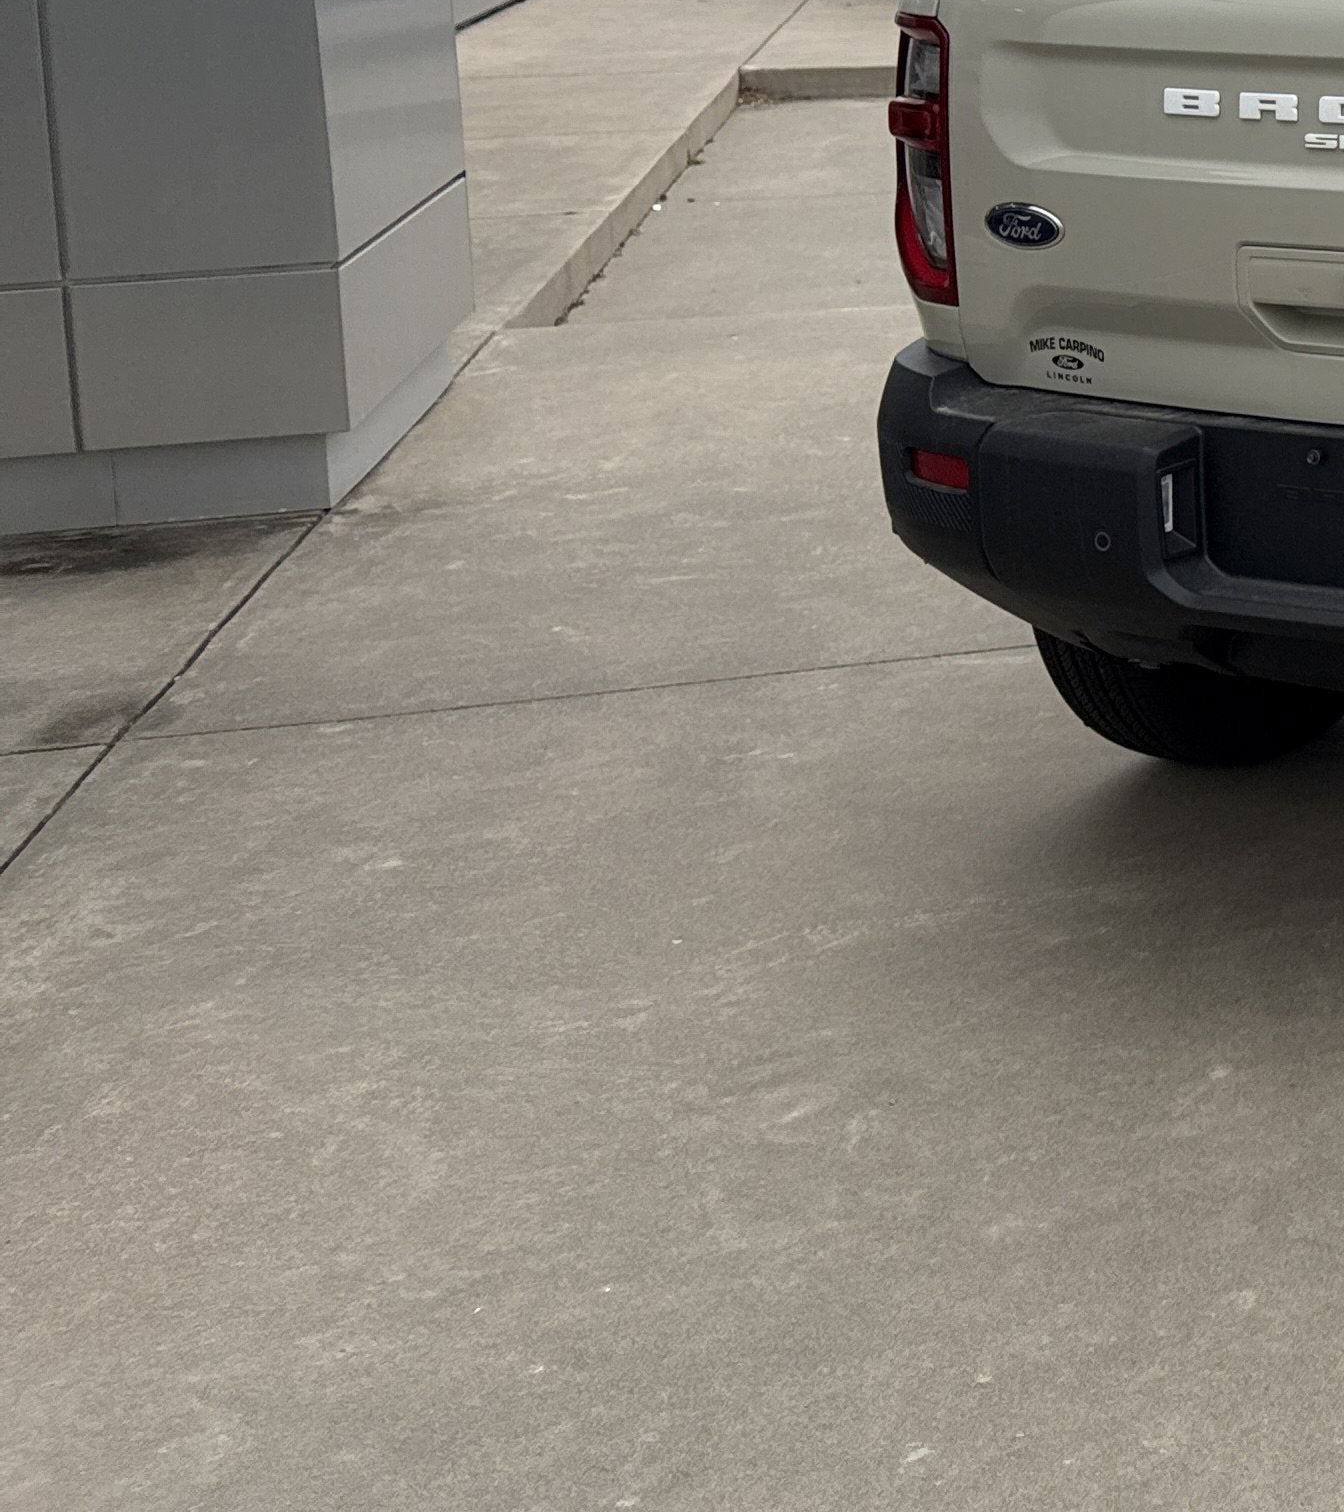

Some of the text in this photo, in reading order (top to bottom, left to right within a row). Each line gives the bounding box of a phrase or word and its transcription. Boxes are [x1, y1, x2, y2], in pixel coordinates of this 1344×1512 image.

[998, 212, 1042, 241] Ford
[1029, 336, 1105, 363] MIKE CARPINO
[1046, 370, 1093, 385] LINCOLN
